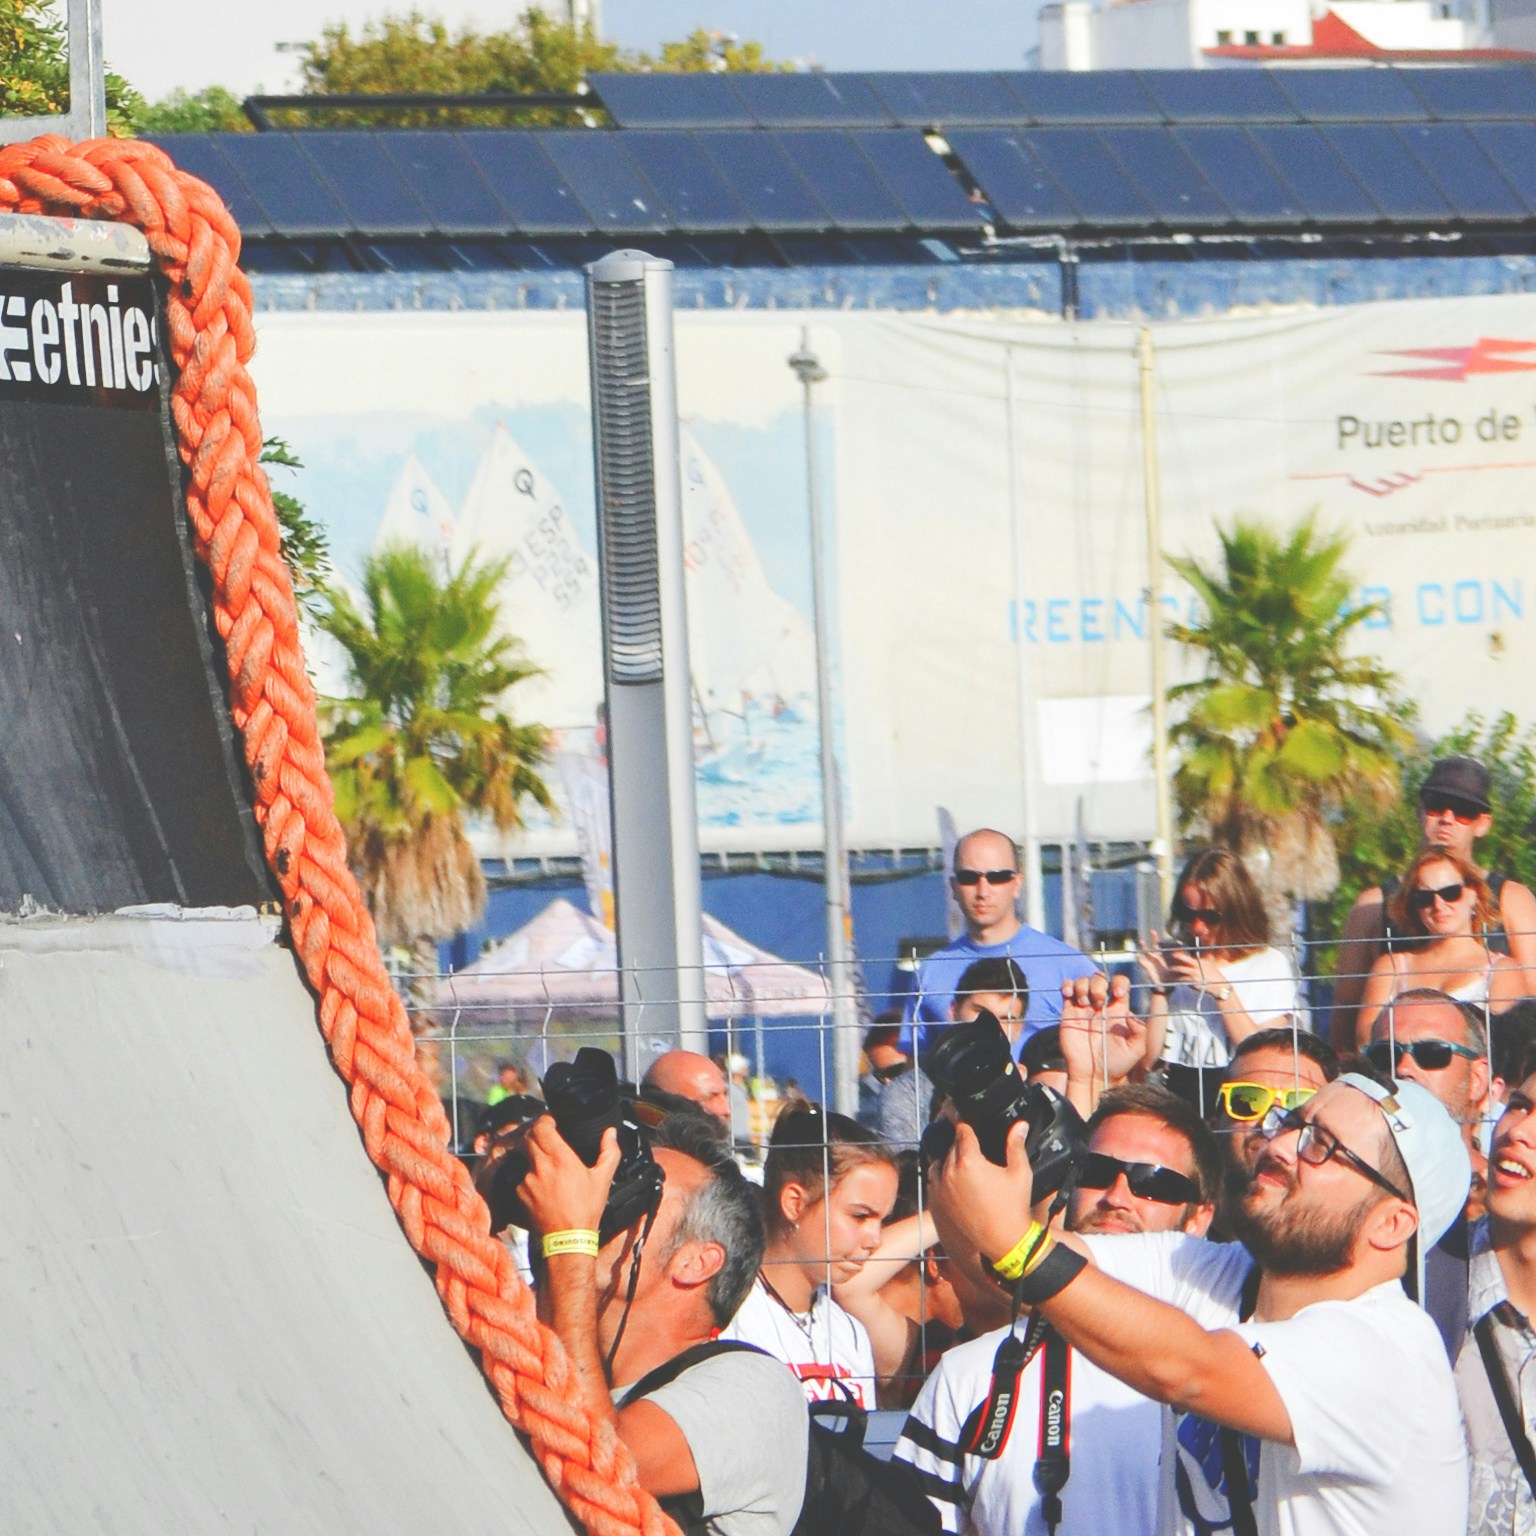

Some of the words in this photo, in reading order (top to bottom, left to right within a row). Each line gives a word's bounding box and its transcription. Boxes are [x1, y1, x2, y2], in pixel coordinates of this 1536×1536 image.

[1336, 413, 1462, 450] Puerto
[1476, 407, 1522, 443] de
[1417, 579, 1523, 625] CON
[980, 1392, 1011, 1453] Canon
[1048, 1388, 1064, 1447] Canon
